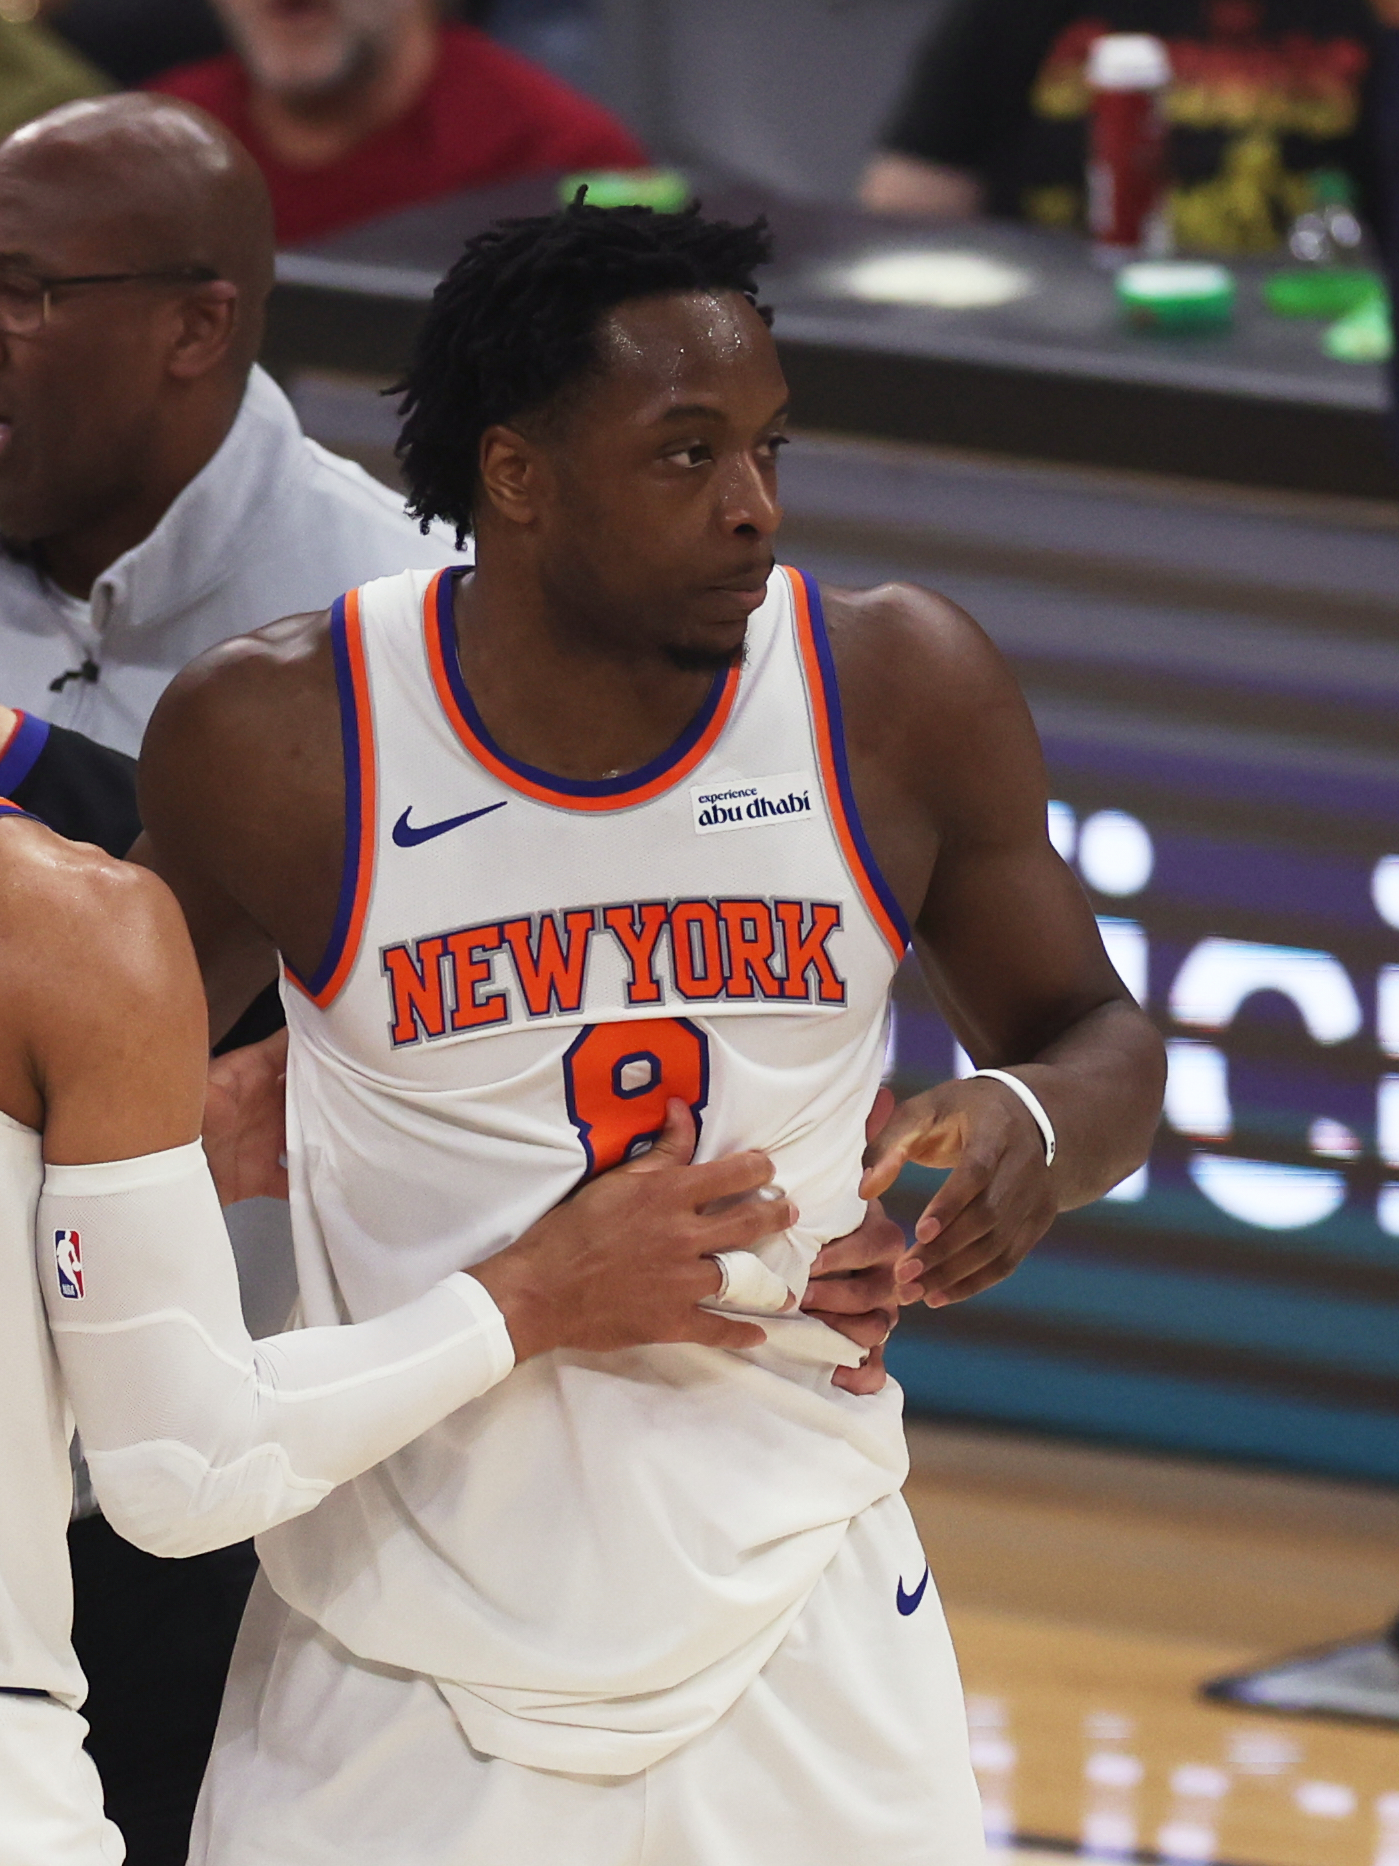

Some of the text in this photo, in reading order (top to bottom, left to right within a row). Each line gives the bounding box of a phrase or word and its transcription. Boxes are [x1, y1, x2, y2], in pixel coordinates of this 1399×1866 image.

[698, 787, 758, 804] experience
[698, 790, 811, 826] abu dhabi
[379, 895, 848, 1050] NEW YORK
[562, 1017, 710, 1178] 8
